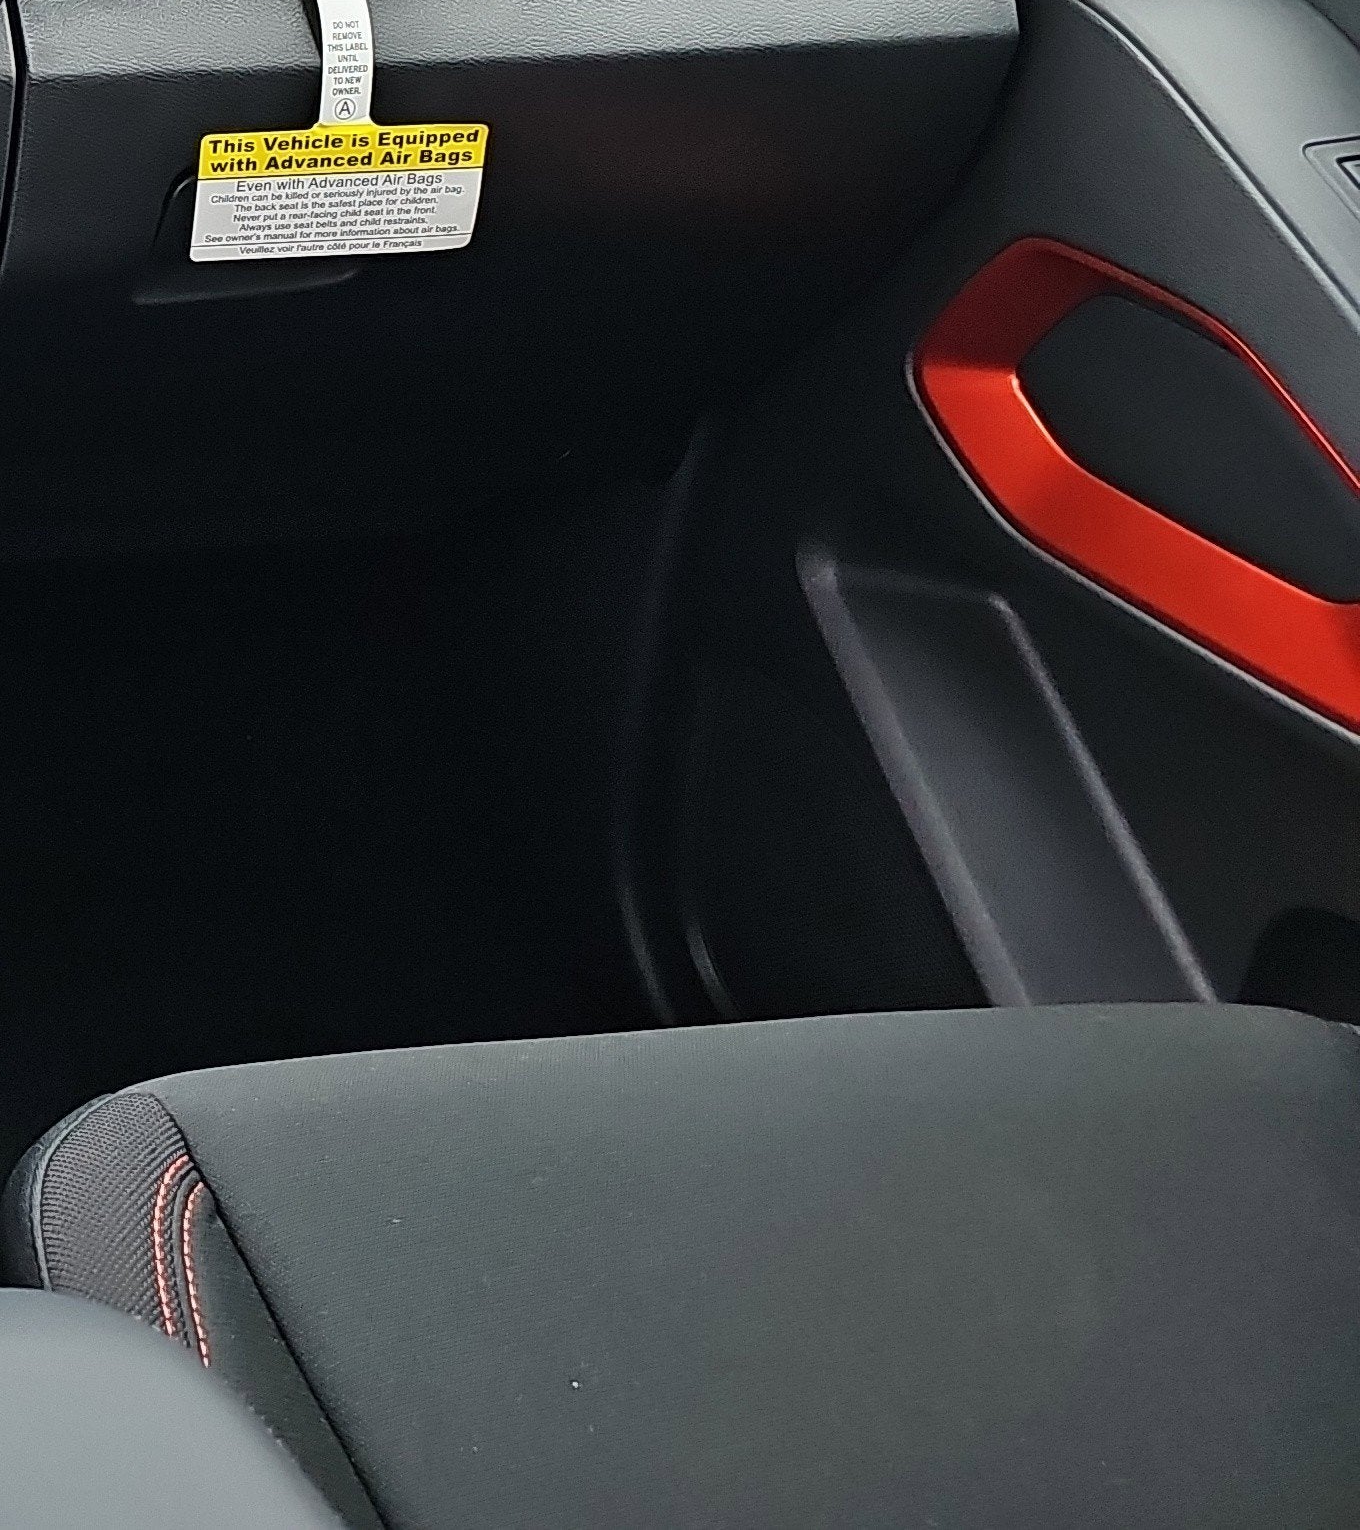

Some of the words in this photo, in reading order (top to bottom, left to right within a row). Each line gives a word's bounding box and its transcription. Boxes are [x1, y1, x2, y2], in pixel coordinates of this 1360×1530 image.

[333, 21, 343, 29] DO
[345, 21, 359, 29] NOT
[332, 32, 362, 40] REMOVE
[328, 44, 343, 52] THIS
[328, 65, 368, 74] DELIVERED
[334, 77, 343, 85] TO
[345, 76, 362, 84] NEW
[339, 101, 350, 115] A
[209, 139, 255, 154] This
[263, 135, 343, 151] Vehicle
[352, 134, 369, 147] is
[378, 129, 479, 148] Equipped
[211, 158, 257, 172] with
[265, 152, 372, 170] Advanced
[380, 151, 412, 165] Air
[420, 150, 472, 165] Bags
[236, 181, 271, 192] Even
[277, 179, 304, 189] with
[308, 175, 378, 189] Advanced
[382, 174, 403, 185] Air
[407, 173, 442, 186] Bags
[211, 195, 249, 203] Children
[285, 191, 308, 199] killed
[324, 190, 364, 198] seriously
[366, 188, 397, 196] injured
[400, 188, 411, 196] by
[235, 204, 252, 212] The
[255, 203, 276, 211] back
[301, 201, 309, 209] is
[328, 200, 356, 208] safest
[358, 199, 382, 208] place
